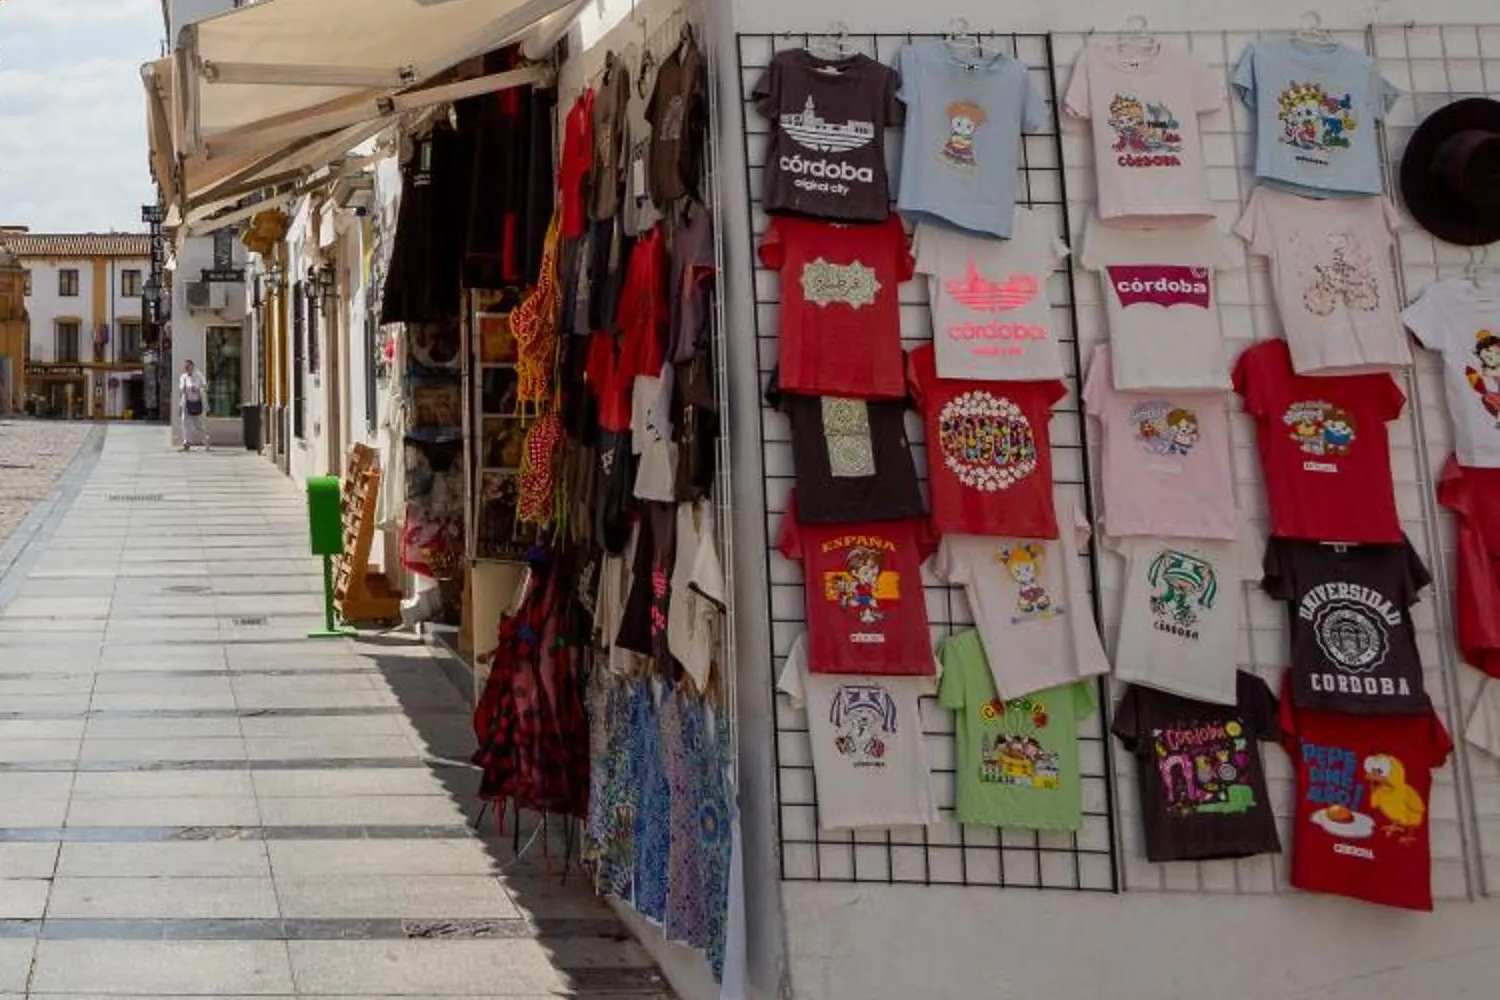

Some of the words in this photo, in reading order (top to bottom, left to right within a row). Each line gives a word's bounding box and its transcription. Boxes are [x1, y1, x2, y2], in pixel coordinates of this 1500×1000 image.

[779, 154, 873, 183] córdoba
[1117, 277, 1207, 294] córdoba
[1299, 581, 1402, 625] UNIVERSIDAD
